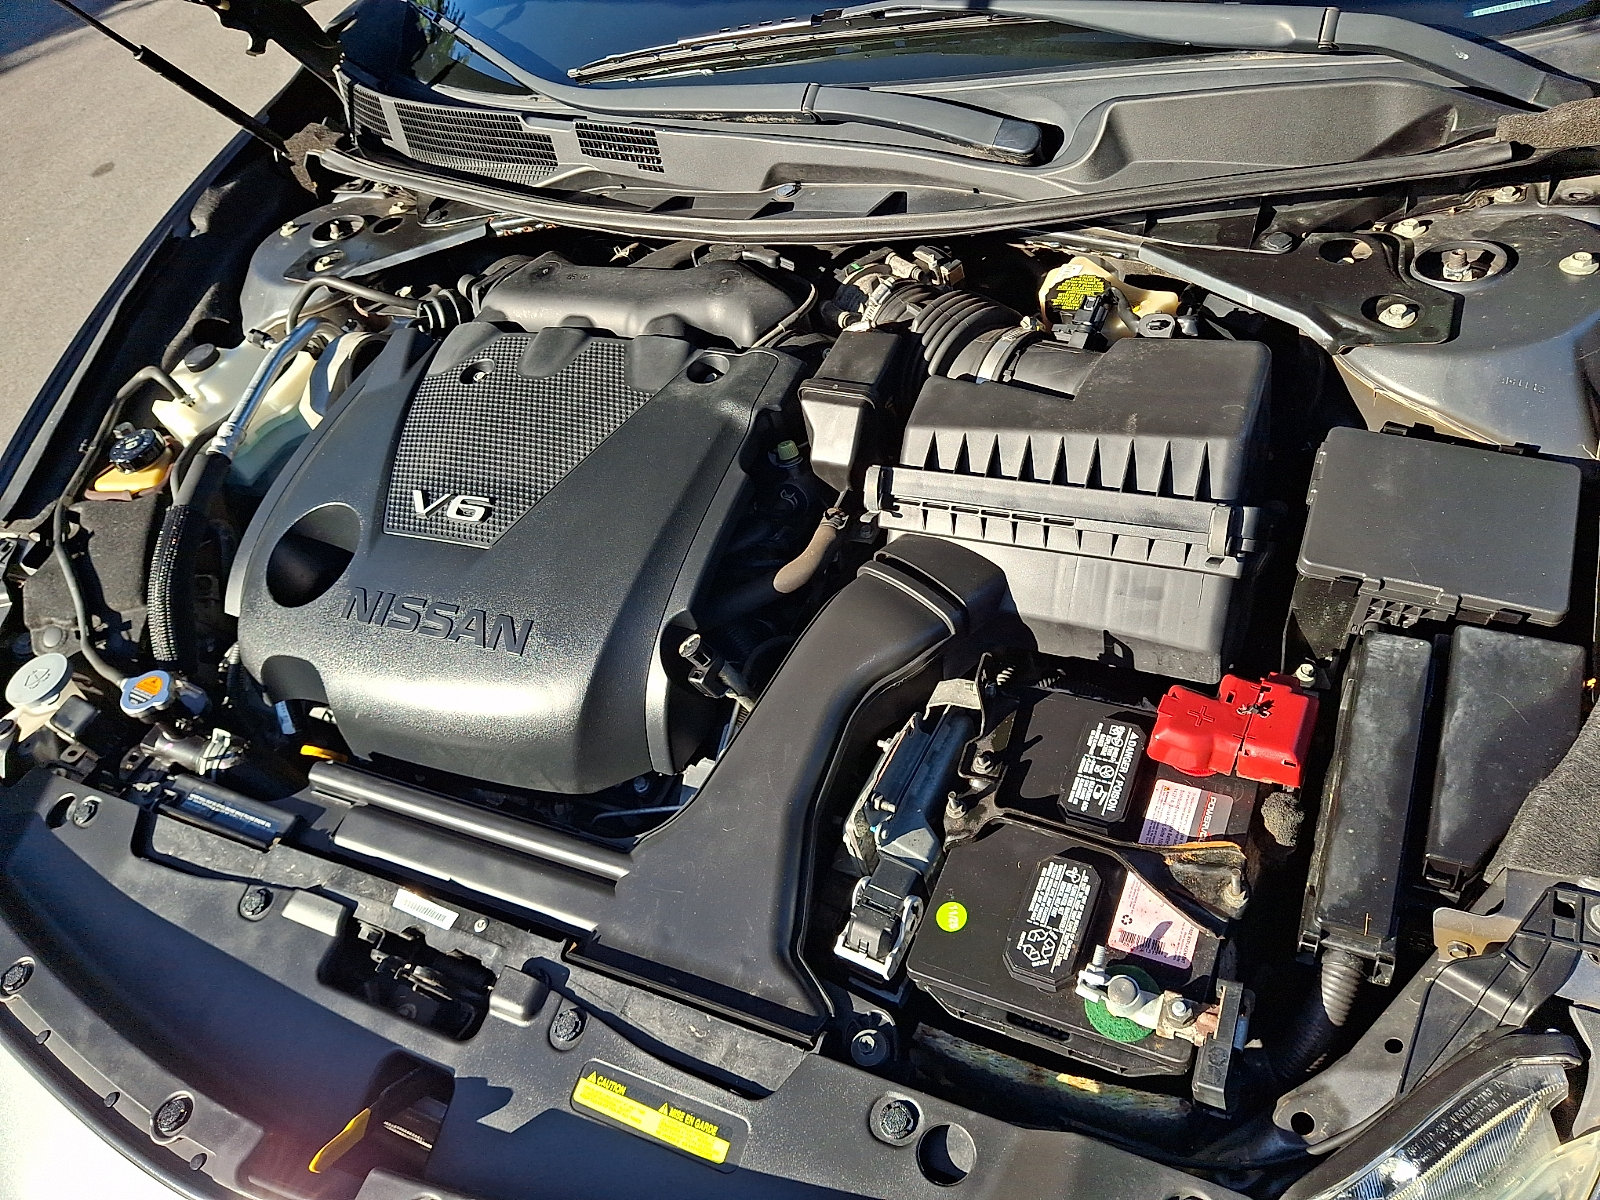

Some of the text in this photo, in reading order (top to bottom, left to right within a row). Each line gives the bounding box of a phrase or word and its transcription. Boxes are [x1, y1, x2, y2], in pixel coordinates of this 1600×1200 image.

[412, 489, 492, 523] V6
[341, 587, 534, 656] NISSAN
[1119, 739, 1136, 773] DANGER
[1107, 779, 1124, 811] POISON
[1199, 796, 1217, 842] POWERVOL
[597, 1076, 627, 1096] CAUTION
[669, 1107, 719, 1136] MISE EN GARDE
